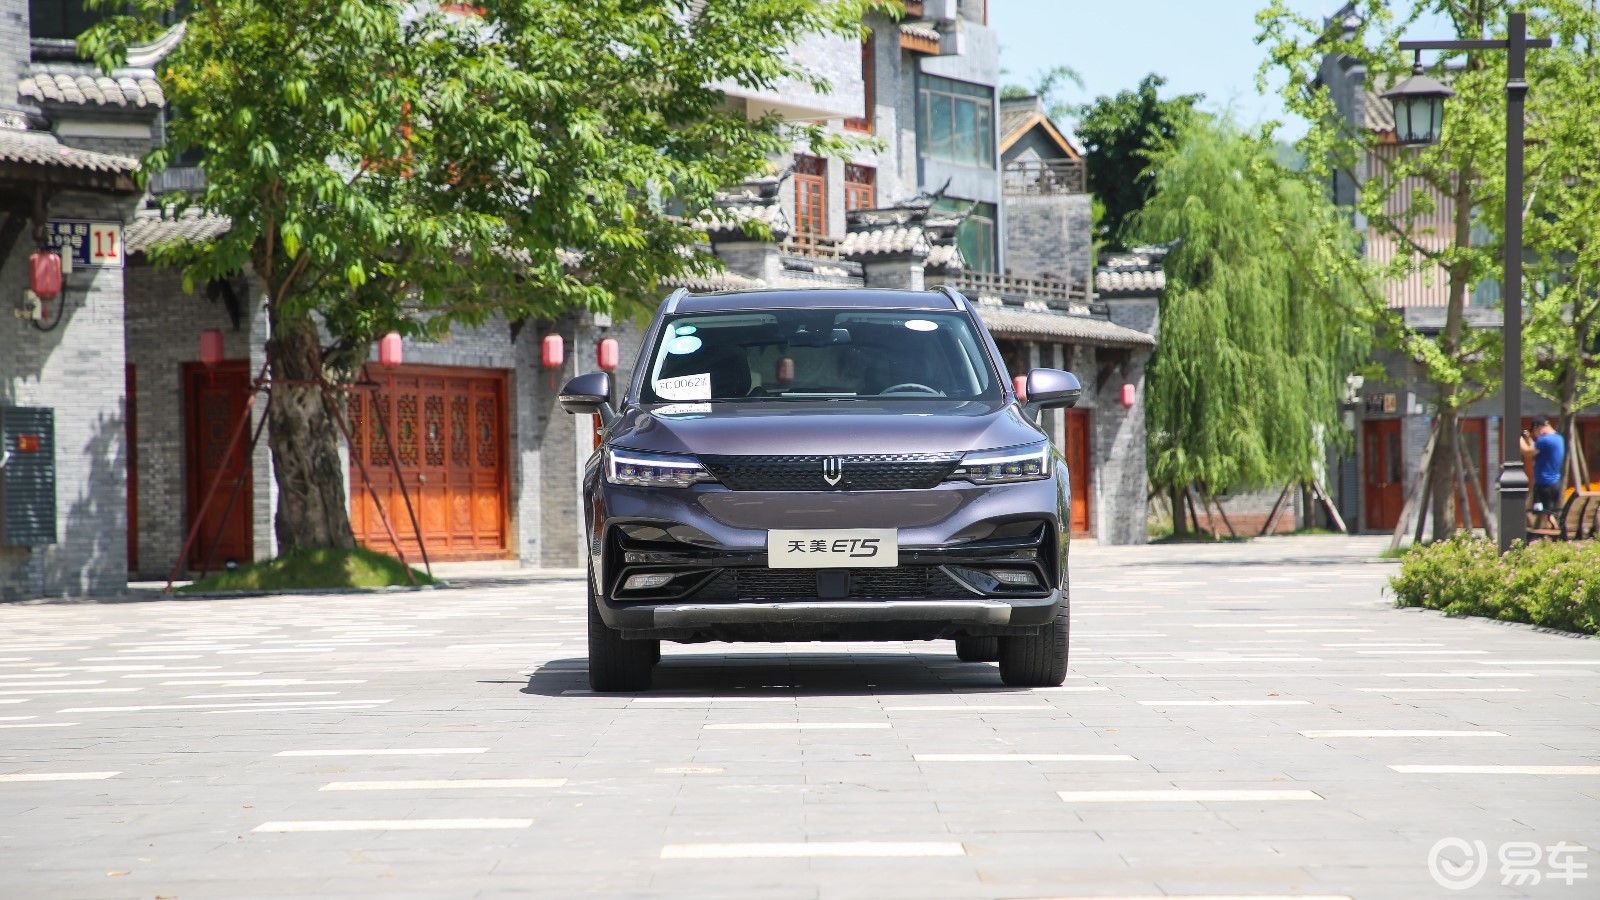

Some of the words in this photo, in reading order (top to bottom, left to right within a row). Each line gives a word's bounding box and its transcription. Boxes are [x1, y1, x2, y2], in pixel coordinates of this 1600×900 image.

[94, 230, 117, 257] 11
[787, 539, 828, 553] 天美
[831, 538, 881, 558] ET5
